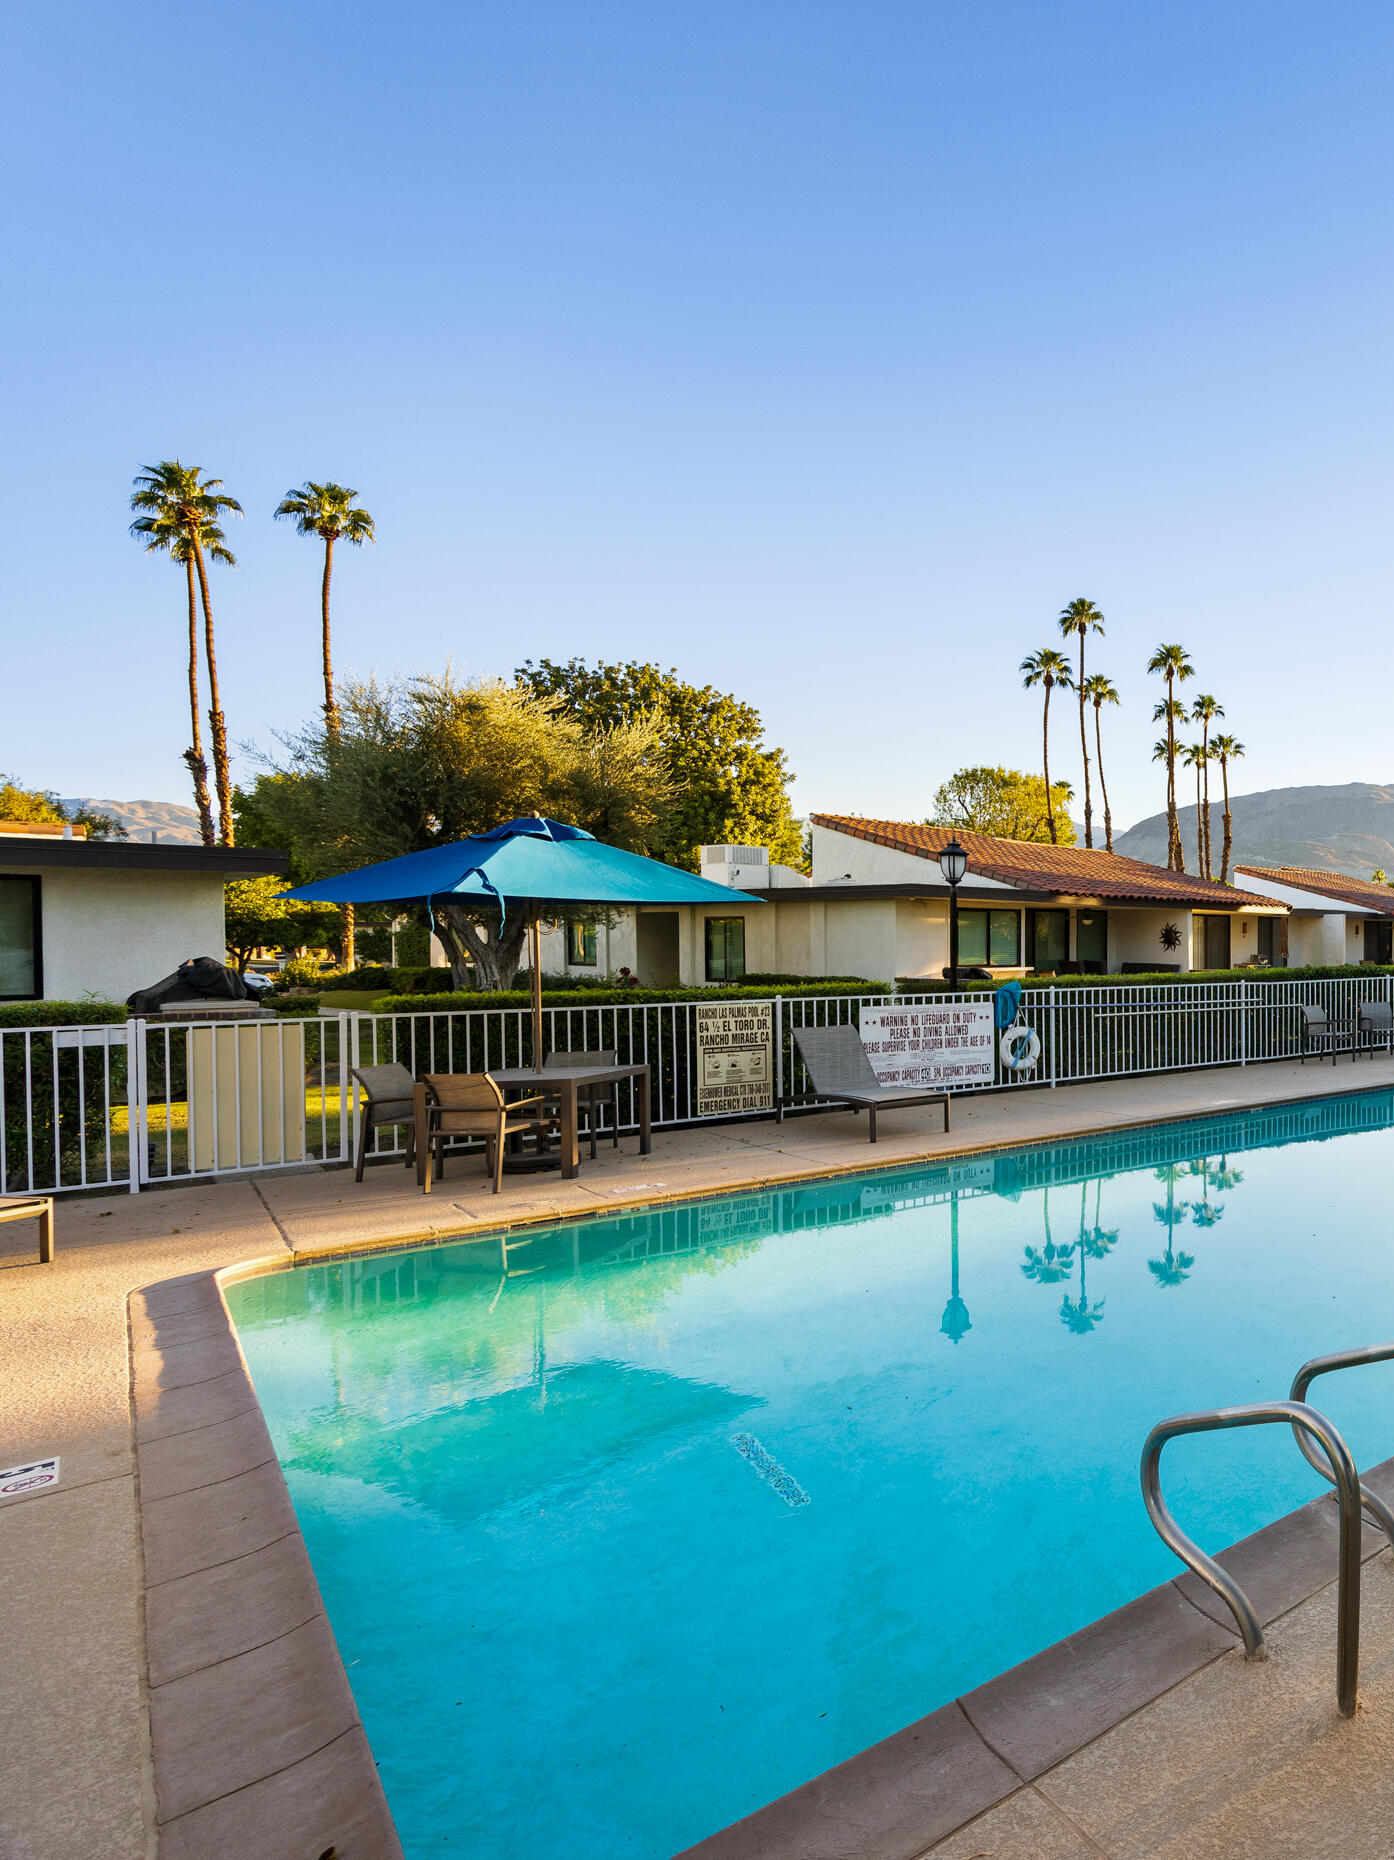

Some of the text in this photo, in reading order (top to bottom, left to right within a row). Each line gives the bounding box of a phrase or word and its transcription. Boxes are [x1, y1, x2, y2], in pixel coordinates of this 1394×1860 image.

[698, 1005, 770, 1020] RANCHO LAS PALMAS POOL #23
[880, 1012, 976, 1027] WARNING NO LIFEGUARD ON DUTY
[699, 1021, 709, 1034] 64
[723, 1020, 732, 1032] EL
[734, 1019, 754, 1031] TORO
[757, 1018, 770, 1030] DR.
[890, 1024, 968, 1040] PLEASE NO DIVING ALLOWED
[700, 1031, 770, 1047] RANCHO MIRAGE CA
[864, 1041, 880, 1054] PLEASE
[882, 1040, 906, 1052] SUPERVISE
[908, 1039, 920, 1051] YOUR
[922, 1038, 942, 1050] CHILDREN
[945, 1037, 959, 1048] UNDER
[970, 1035, 978, 1046] AGE
[980, 1035, 984, 1046] OF
[986, 1034, 991, 1045] 14
[877, 1070, 900, 1083] OCCUPANCY
[902, 1069, 920, 1081] CAPACITY
[921, 1068, 931, 1079] 40
[943, 1066, 963, 1077] OCCUPANCY
[965, 1064, 982, 1076] CAPACITY
[982, 1064, 990, 1074] 10
[700, 1095, 770, 1113] EMERGENCY DIAL 911
